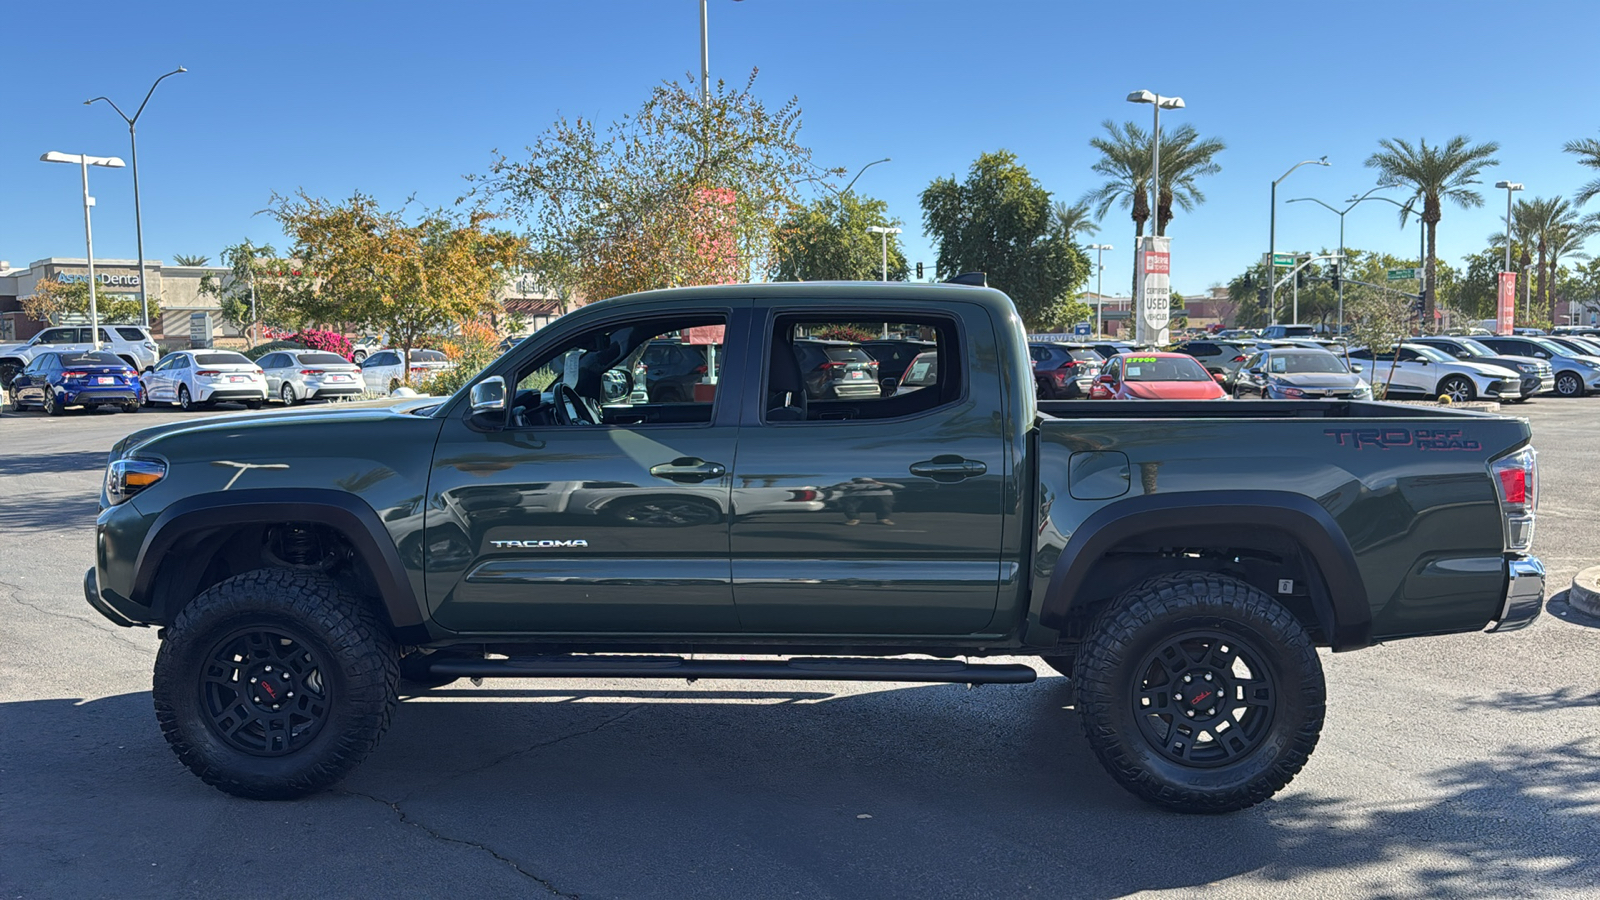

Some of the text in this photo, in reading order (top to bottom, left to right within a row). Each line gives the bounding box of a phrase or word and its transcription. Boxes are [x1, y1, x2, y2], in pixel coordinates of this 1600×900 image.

[1146, 287, 1168, 295] CERTIFIED
[1146, 298, 1168, 310] USED
[1146, 313, 1168, 321] VEHICLES
[1323, 428, 1462, 451] TRD OFF
[1416, 440, 1482, 451] ROAD
[490, 540, 589, 548] TACOMA
[261, 680, 277, 699] TRD
[1191, 690, 1212, 705] TRD
